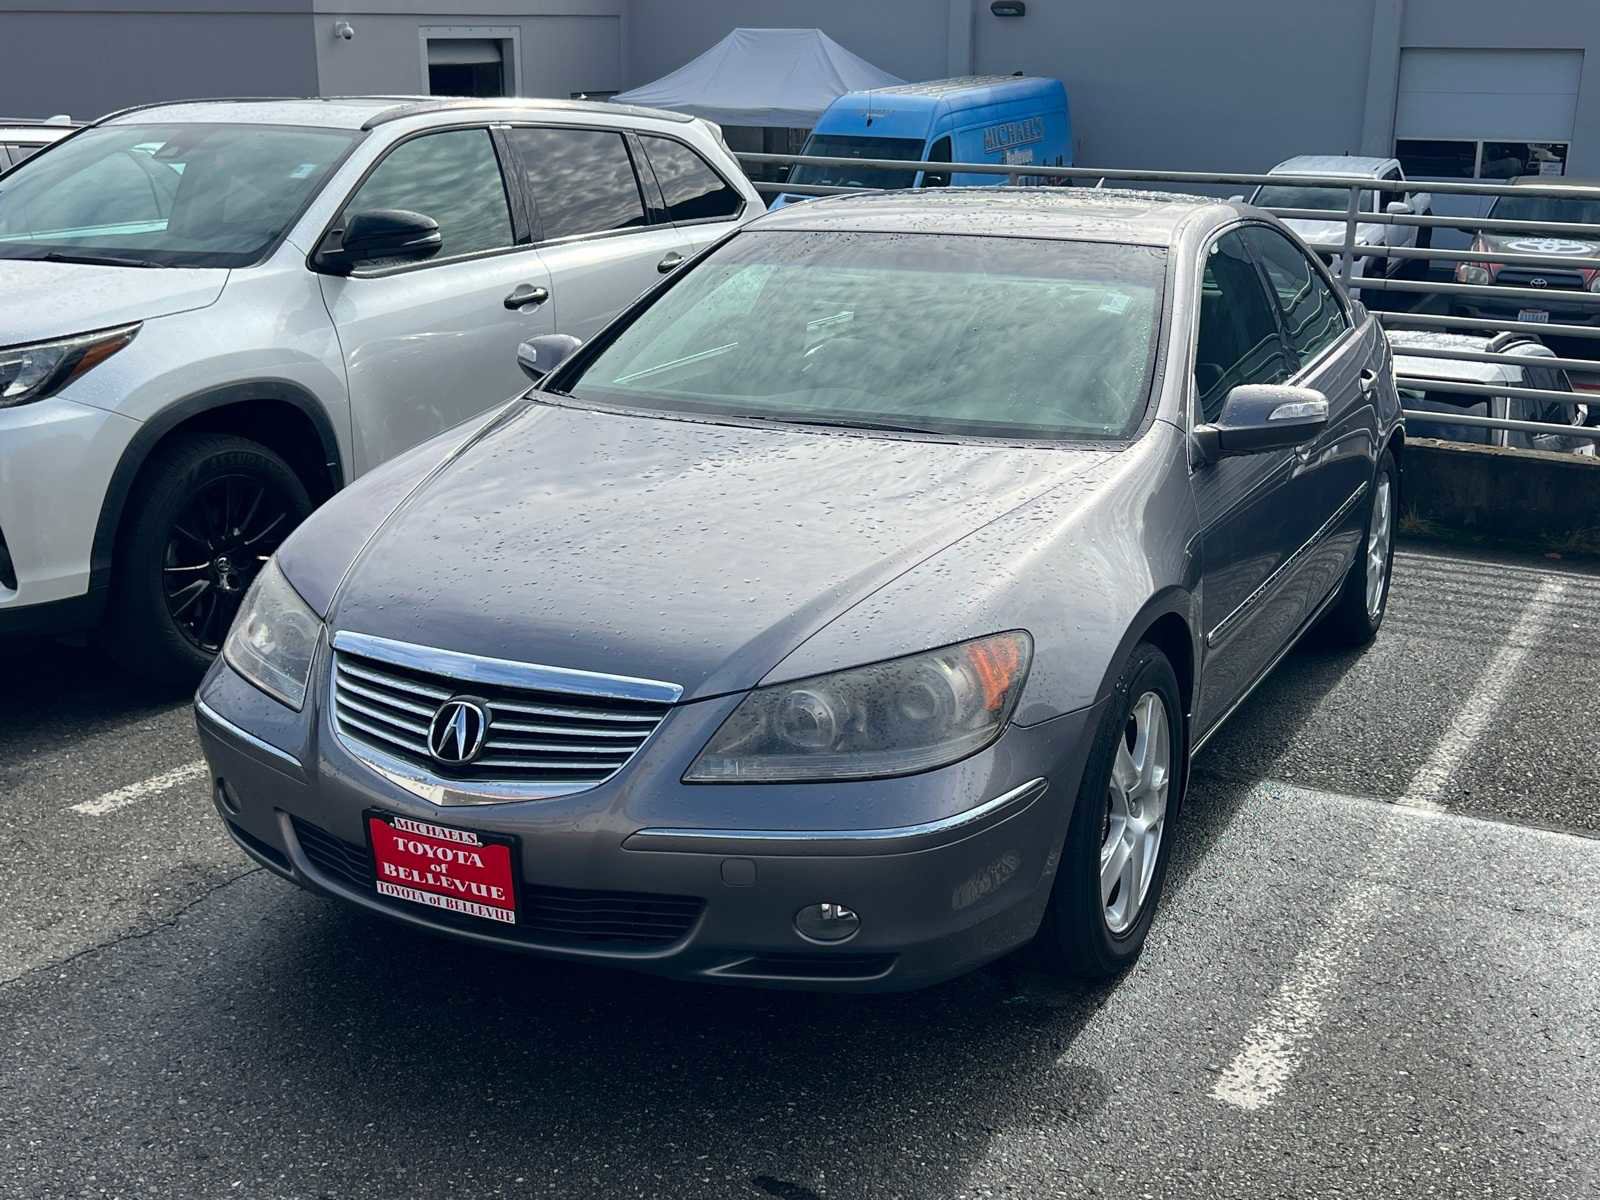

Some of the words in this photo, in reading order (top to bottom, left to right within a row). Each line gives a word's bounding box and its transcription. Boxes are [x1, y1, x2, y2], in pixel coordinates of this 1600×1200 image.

[397, 818, 477, 844] MICHAELS
[393, 836, 485, 868] TOYOTA
[383, 862, 505, 901] BELLEVUE
[430, 863, 448, 874] of
[378, 882, 426, 903] TOYOTA
[429, 896, 442, 905] of
[446, 898, 514, 923] BELLEVUE
